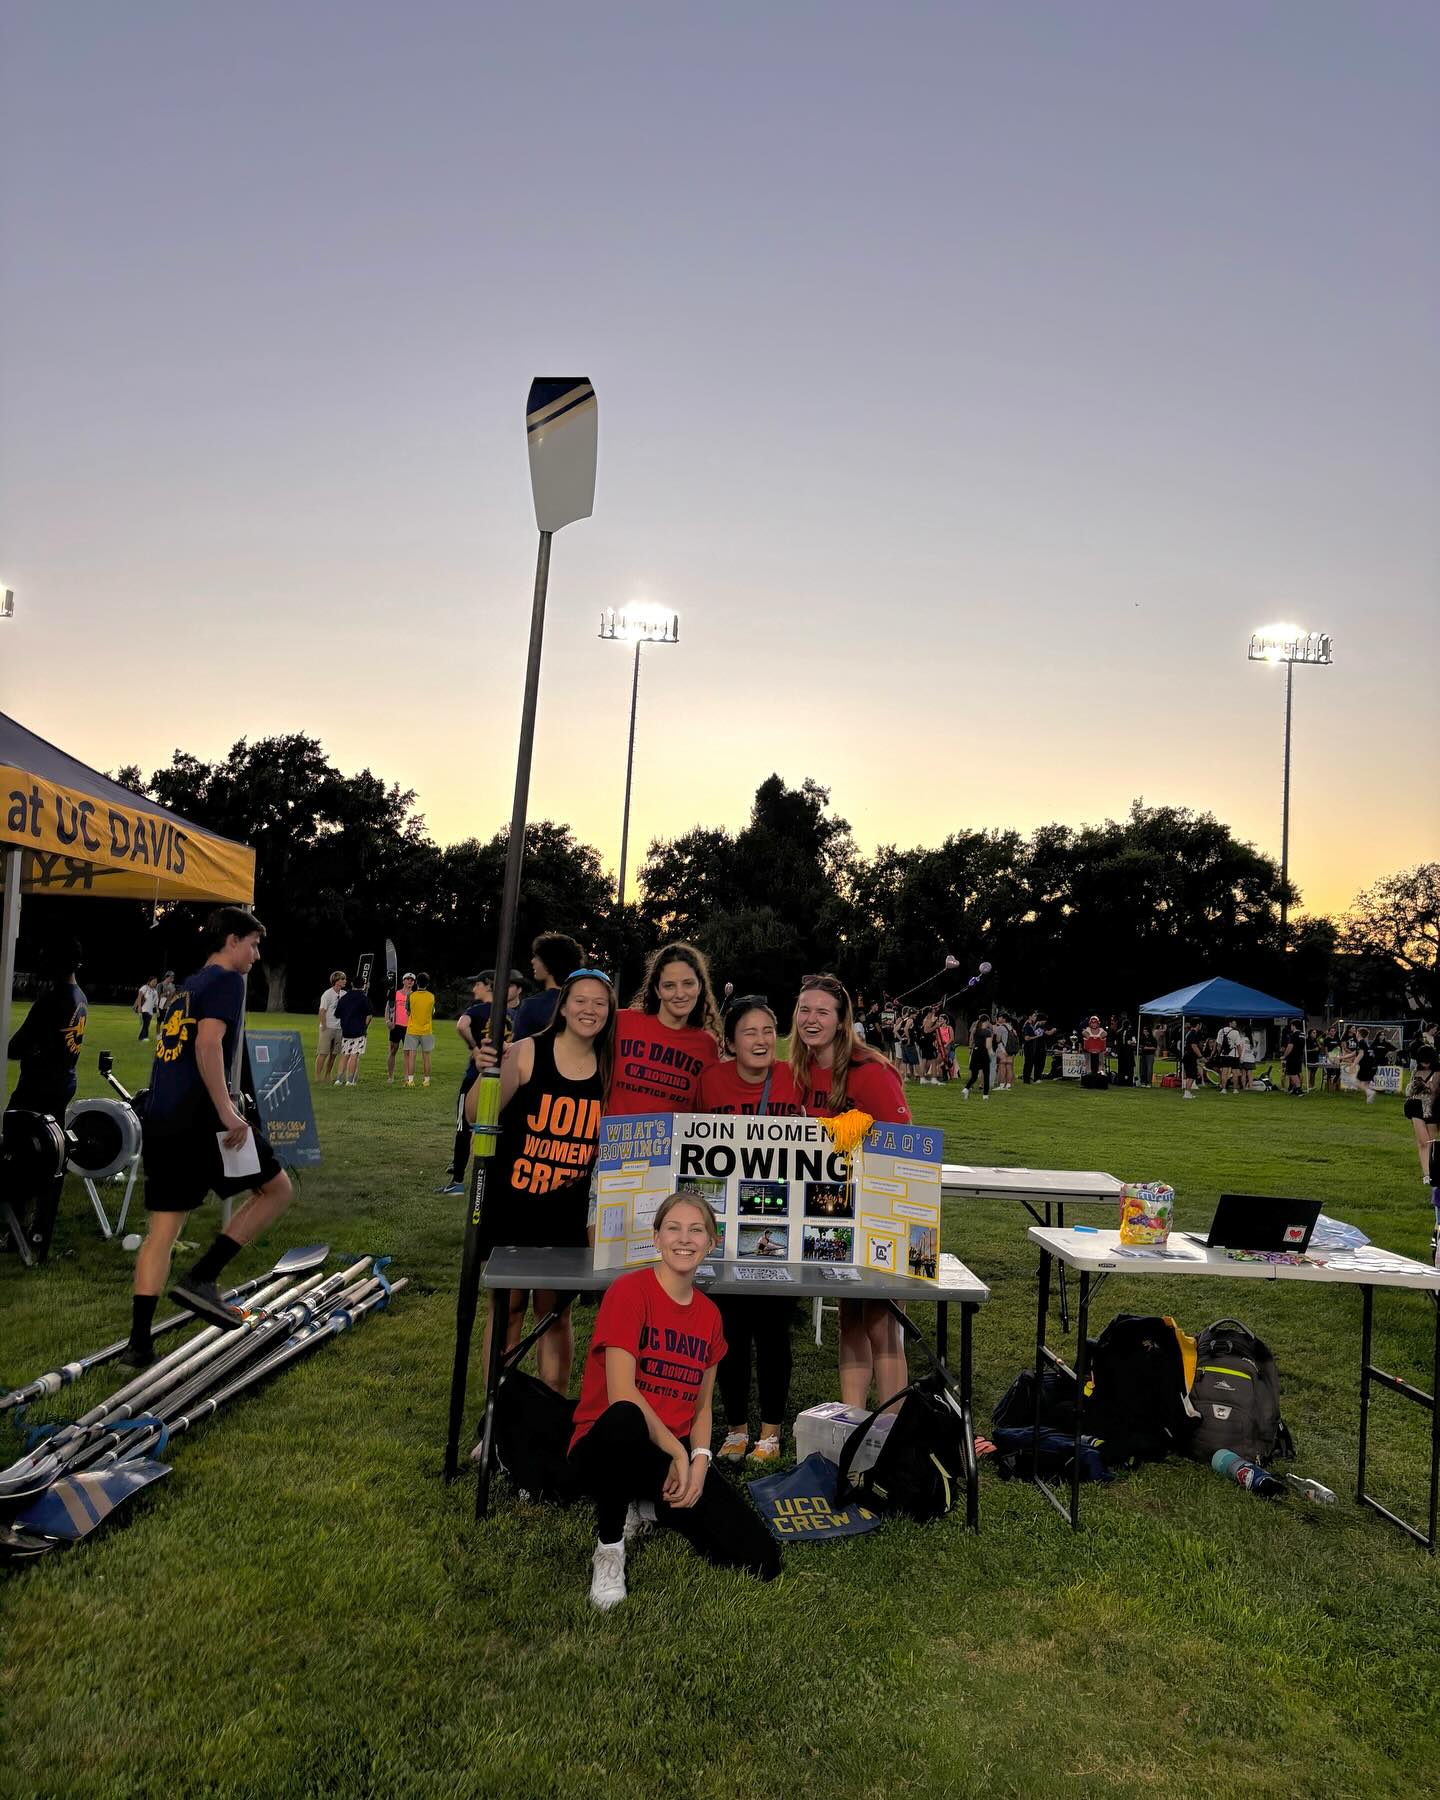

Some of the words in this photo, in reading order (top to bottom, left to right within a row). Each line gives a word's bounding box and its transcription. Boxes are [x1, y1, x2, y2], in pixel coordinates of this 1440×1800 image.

[8, 786, 44, 837] at
[55, 796, 101, 851] UC
[108, 808, 188, 875] DAVIS
[620, 1039, 646, 1058] UC
[648, 1042, 704, 1076] DAVIS
[606, 1120, 666, 1142] WHAT'S
[684, 1121, 734, 1139] JOIN
[600, 1137, 671, 1162] ROWING?
[680, 1143, 854, 1182] ROWING
[662, 1363, 700, 1383] ROWING
[774, 1497, 832, 1516] UCD
[772, 1511, 850, 1533] CREW
